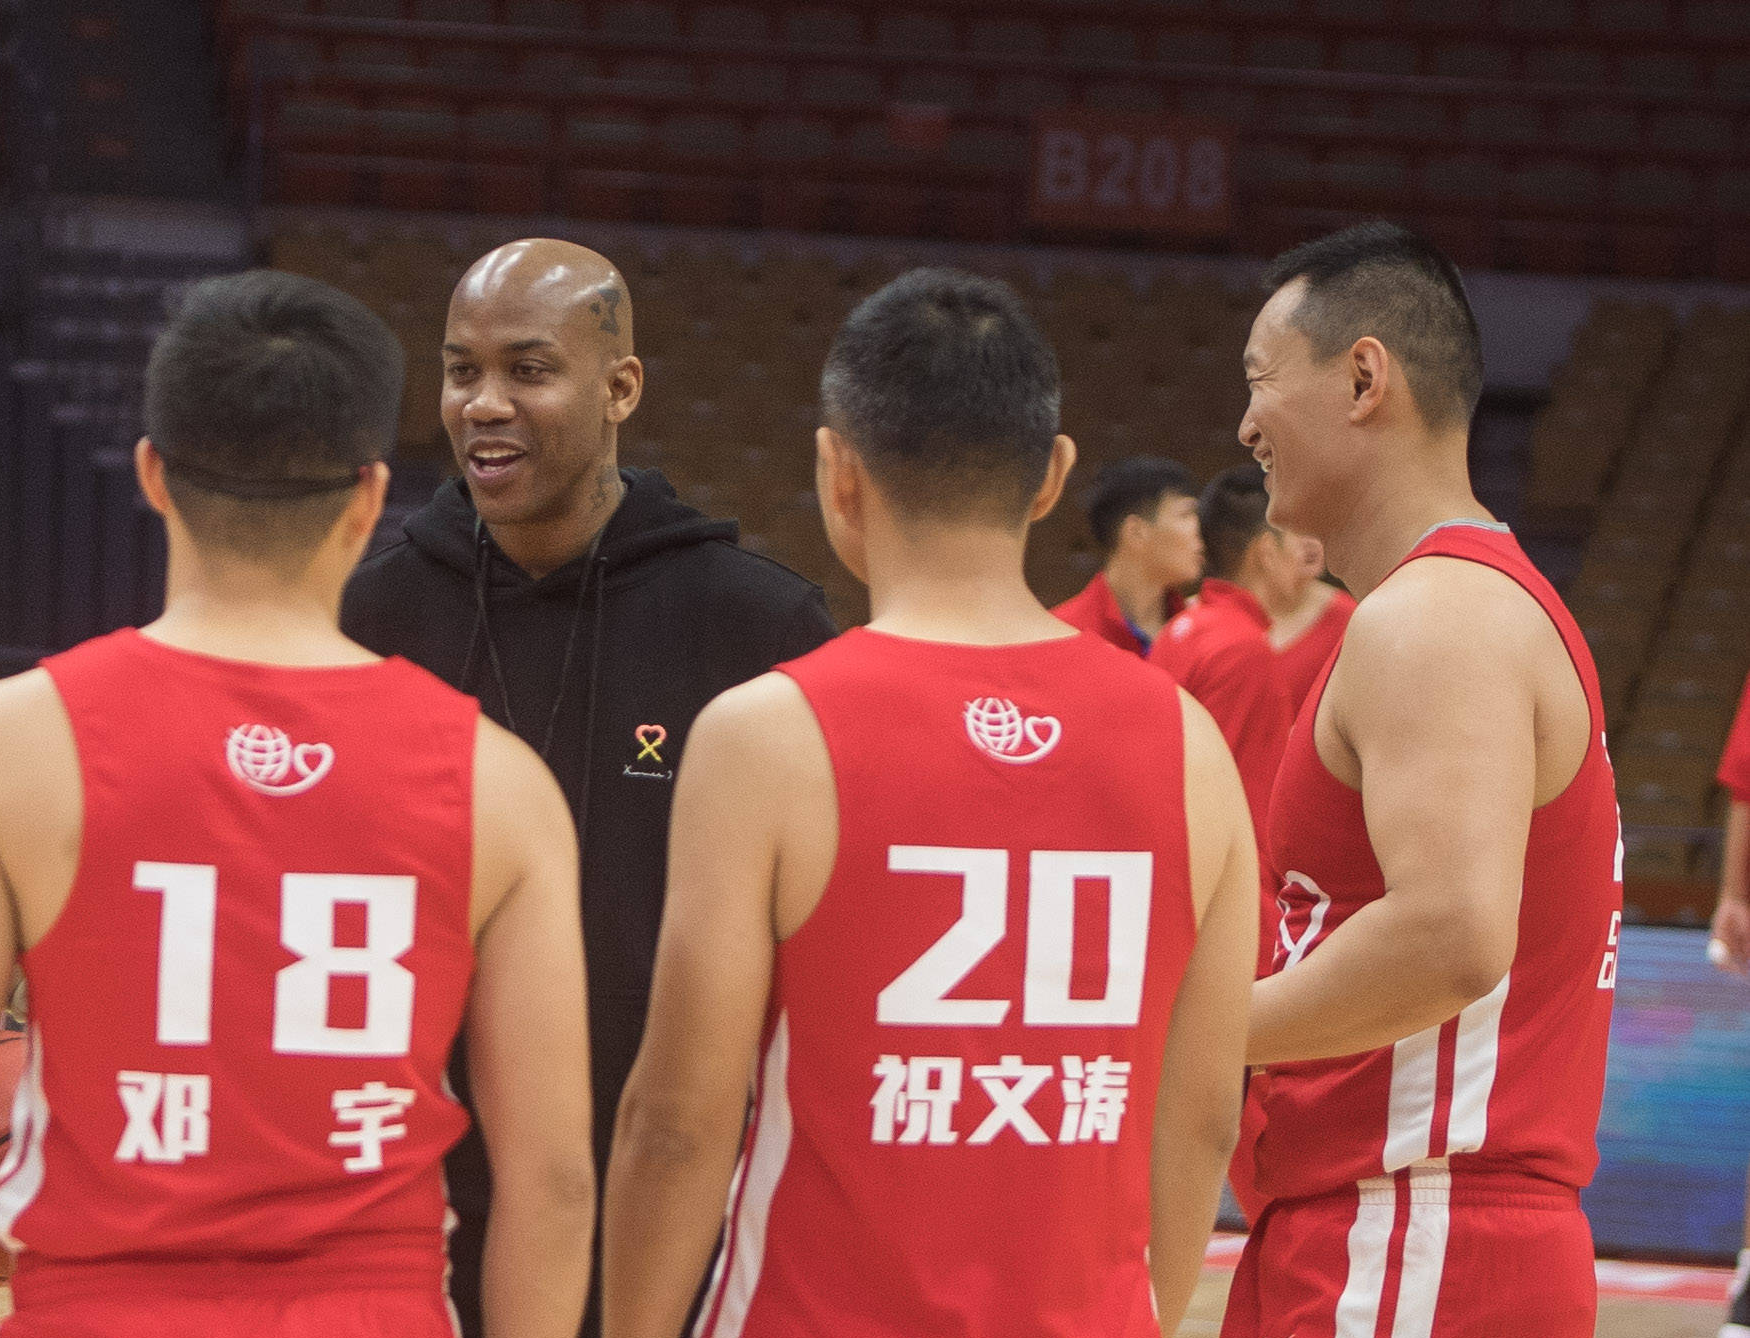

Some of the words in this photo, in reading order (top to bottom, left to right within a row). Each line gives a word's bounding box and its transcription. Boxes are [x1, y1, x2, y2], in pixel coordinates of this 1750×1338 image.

[1036, 128, 1227, 211] B208
[132, 859, 418, 1058] 18
[875, 843, 1154, 1027] 20
[869, 1053, 1133, 1146] 祝文涛
